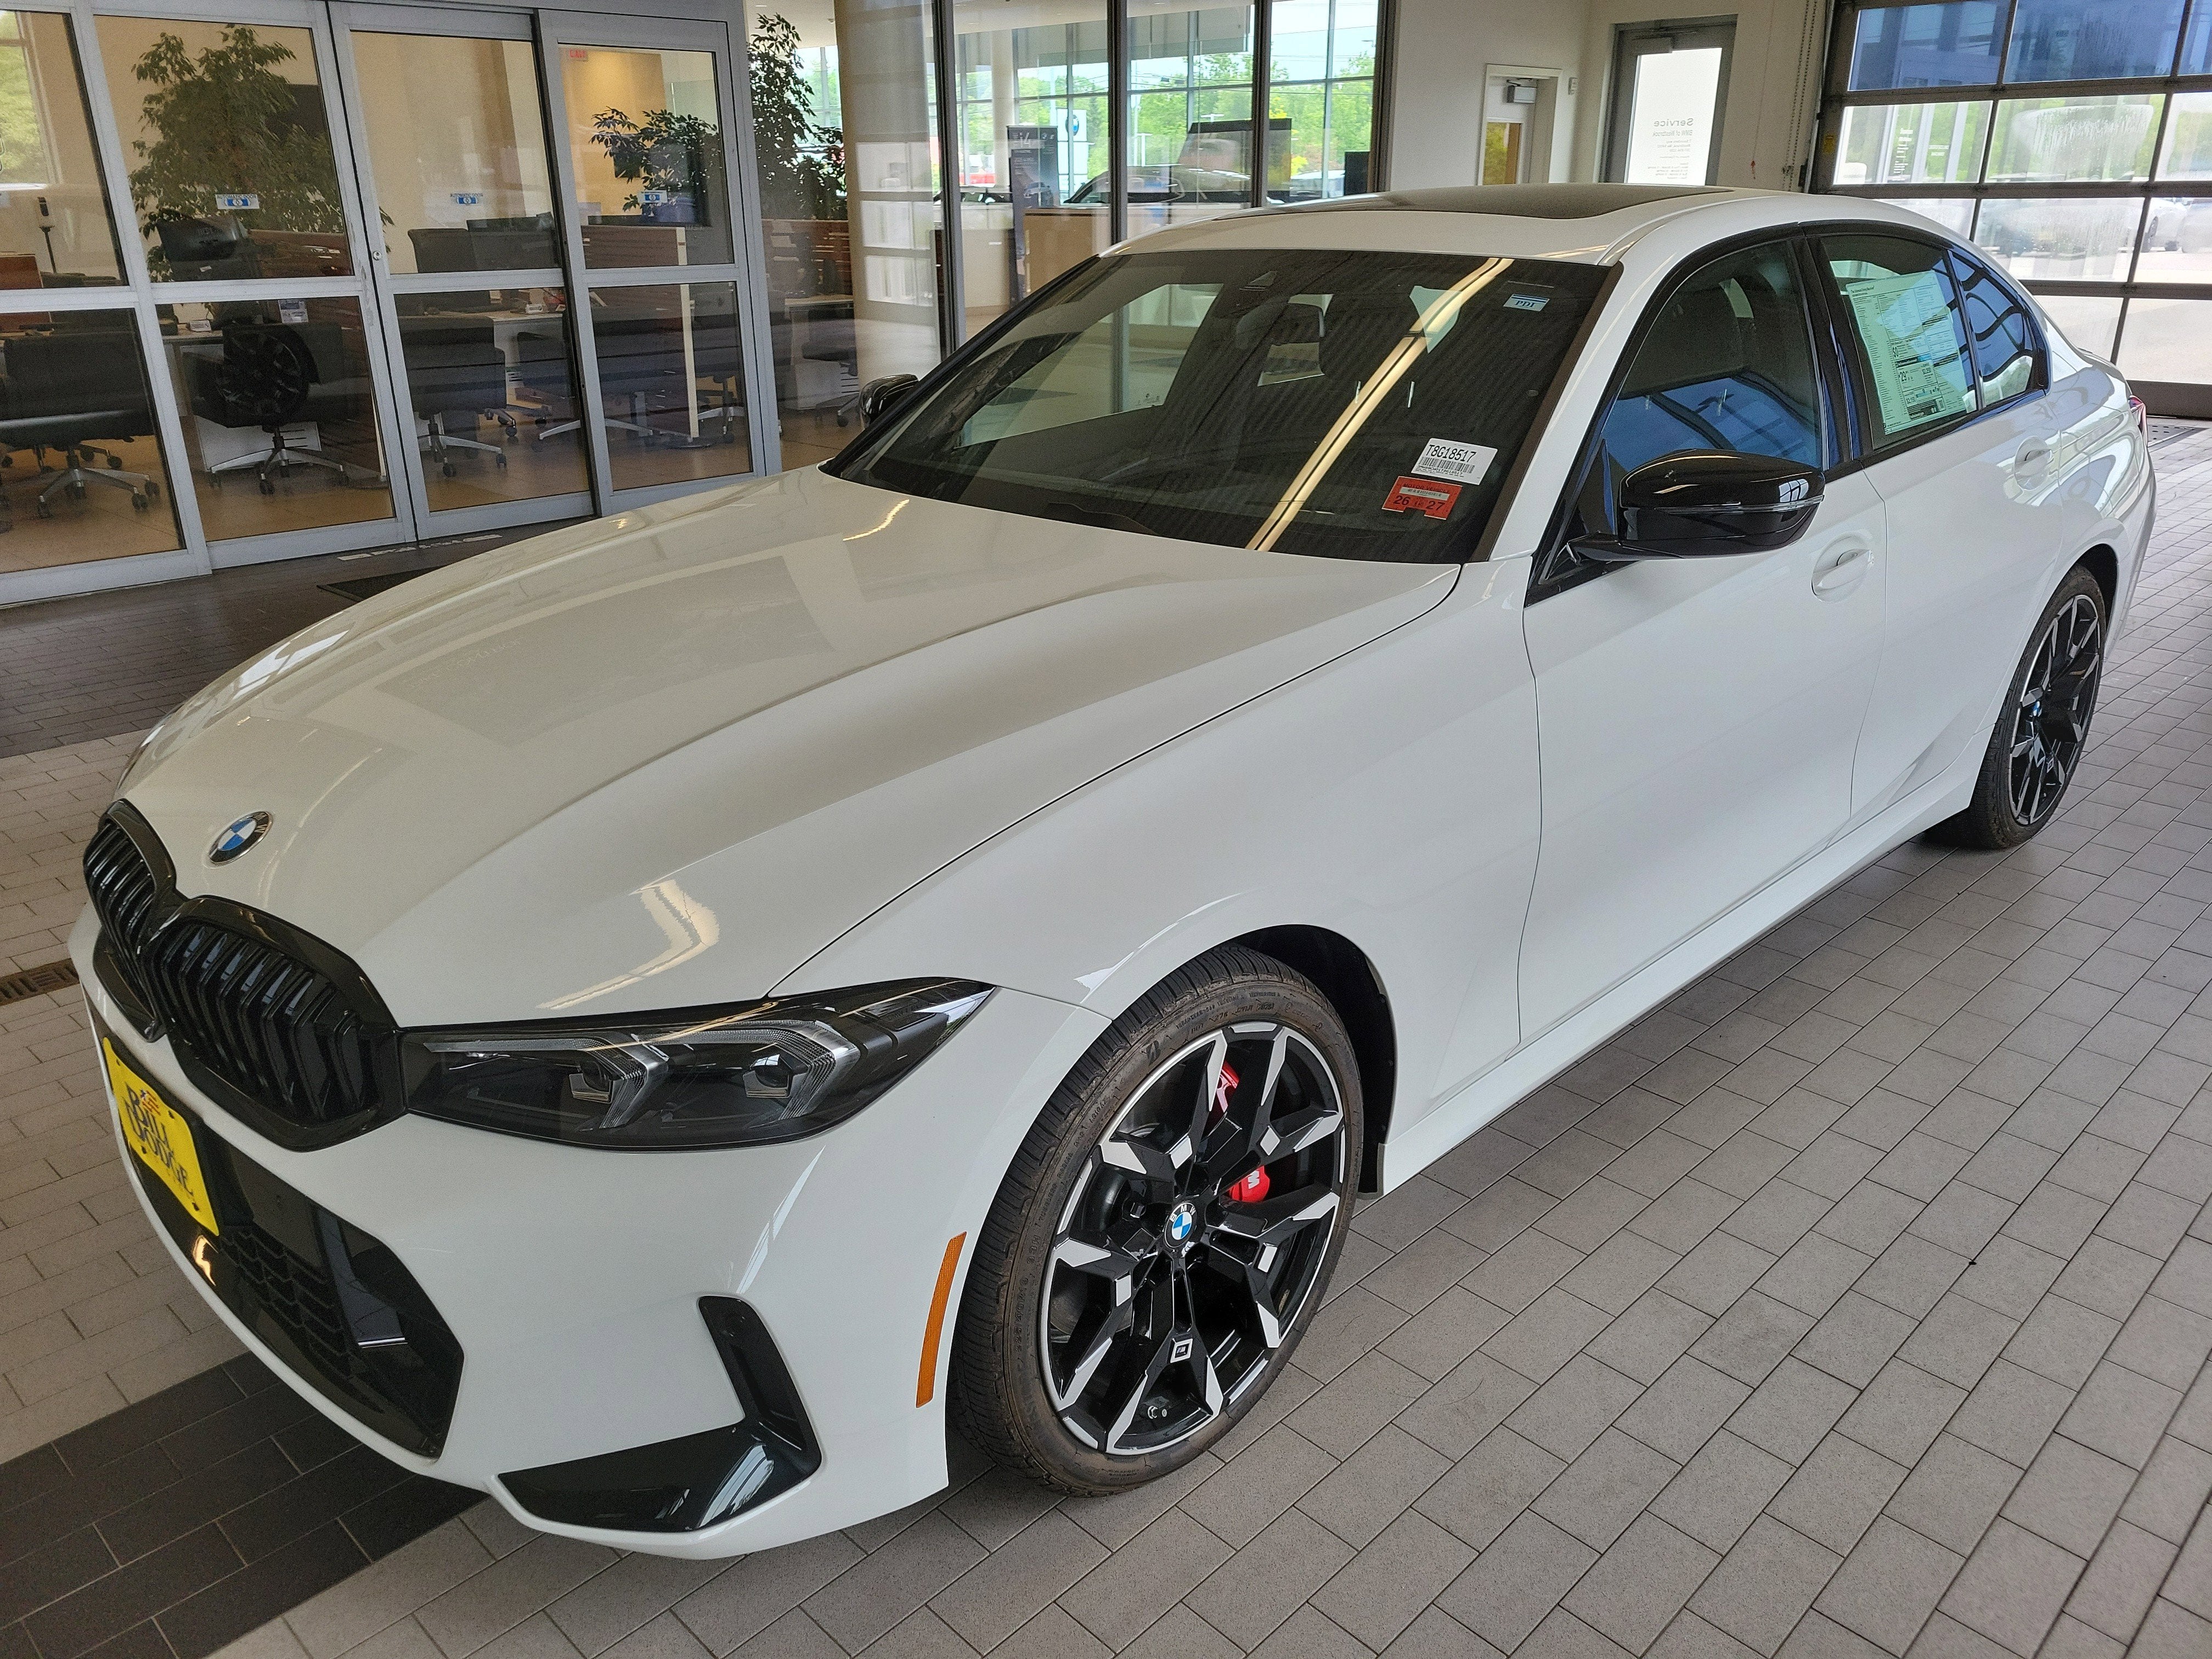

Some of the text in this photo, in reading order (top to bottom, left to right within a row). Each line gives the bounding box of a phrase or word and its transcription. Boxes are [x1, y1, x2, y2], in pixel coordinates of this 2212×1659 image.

[1426, 444, 1477, 462] T8G18517
[1393, 495, 1411, 505] 26
[1426, 500, 1446, 511] 27
[1170, 1204, 1196, 1222] BMW
